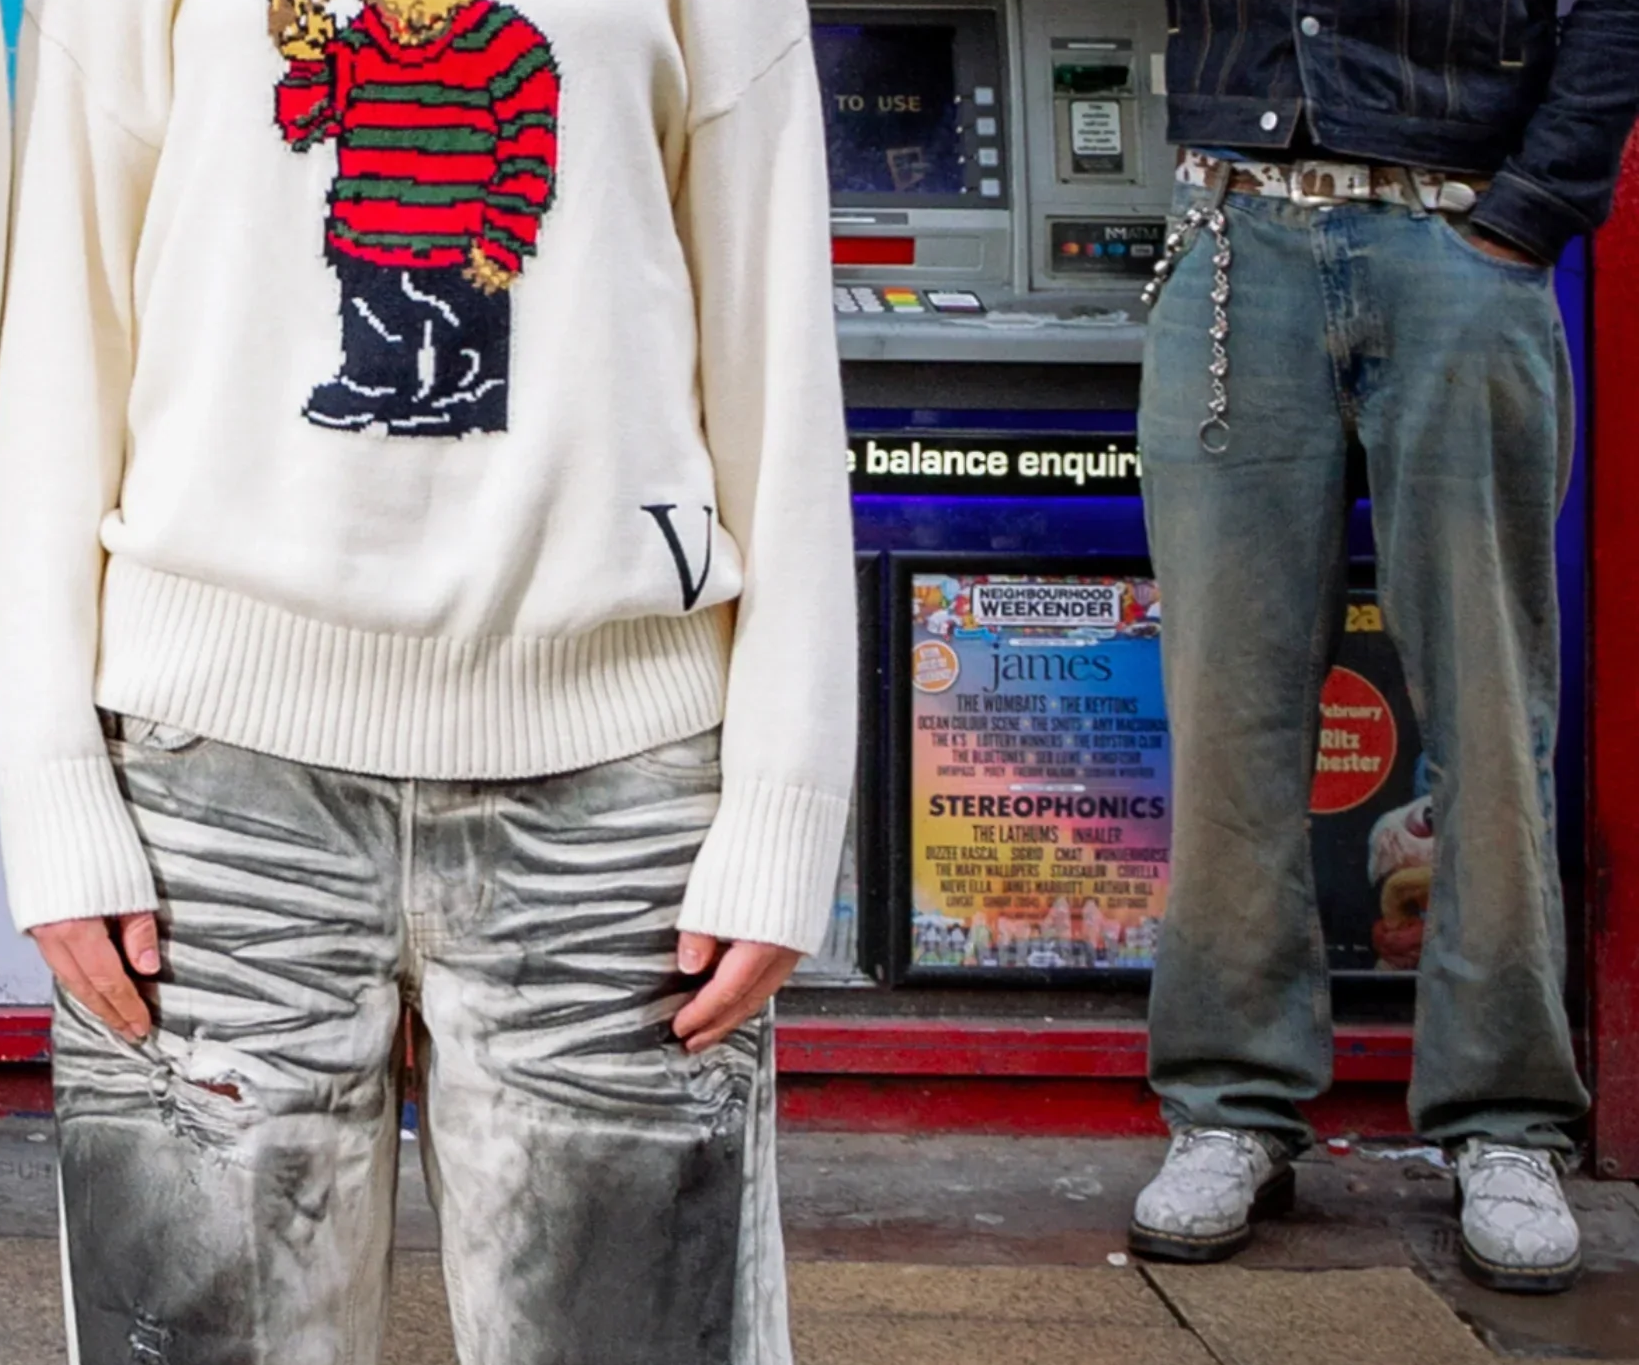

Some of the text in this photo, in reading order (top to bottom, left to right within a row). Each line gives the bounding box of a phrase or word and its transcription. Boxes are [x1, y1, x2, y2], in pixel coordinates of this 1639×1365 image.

[834, 95, 922, 112] TO USE
[867, 441, 1142, 485] balance enquiri
[639, 503, 713, 611] V
[980, 588, 1113, 600] NEIGHBOURHOOD
[981, 602, 1113, 617] WEEKENDER
[983, 643, 1113, 692] james
[956, 695, 979, 713] THE
[983, 695, 1046, 714] WOMBATS
[1060, 696, 1082, 714] THE
[918, 716, 949, 731] OCEAN
[991, 717, 1021, 731] SCENE
[931, 734, 949, 748] THE
[1320, 728, 1360, 749] Ritz
[1316, 752, 1382, 773] hester
[929, 795, 1165, 820] STEREOPHONICS
[972, 825, 1123, 844] THE LATHUMS INHALER
[926, 846, 958, 860] DIZZEE
[961, 847, 999, 861] RASCAL
[936, 863, 953, 877] THE
[955, 863, 982, 877] MARY
